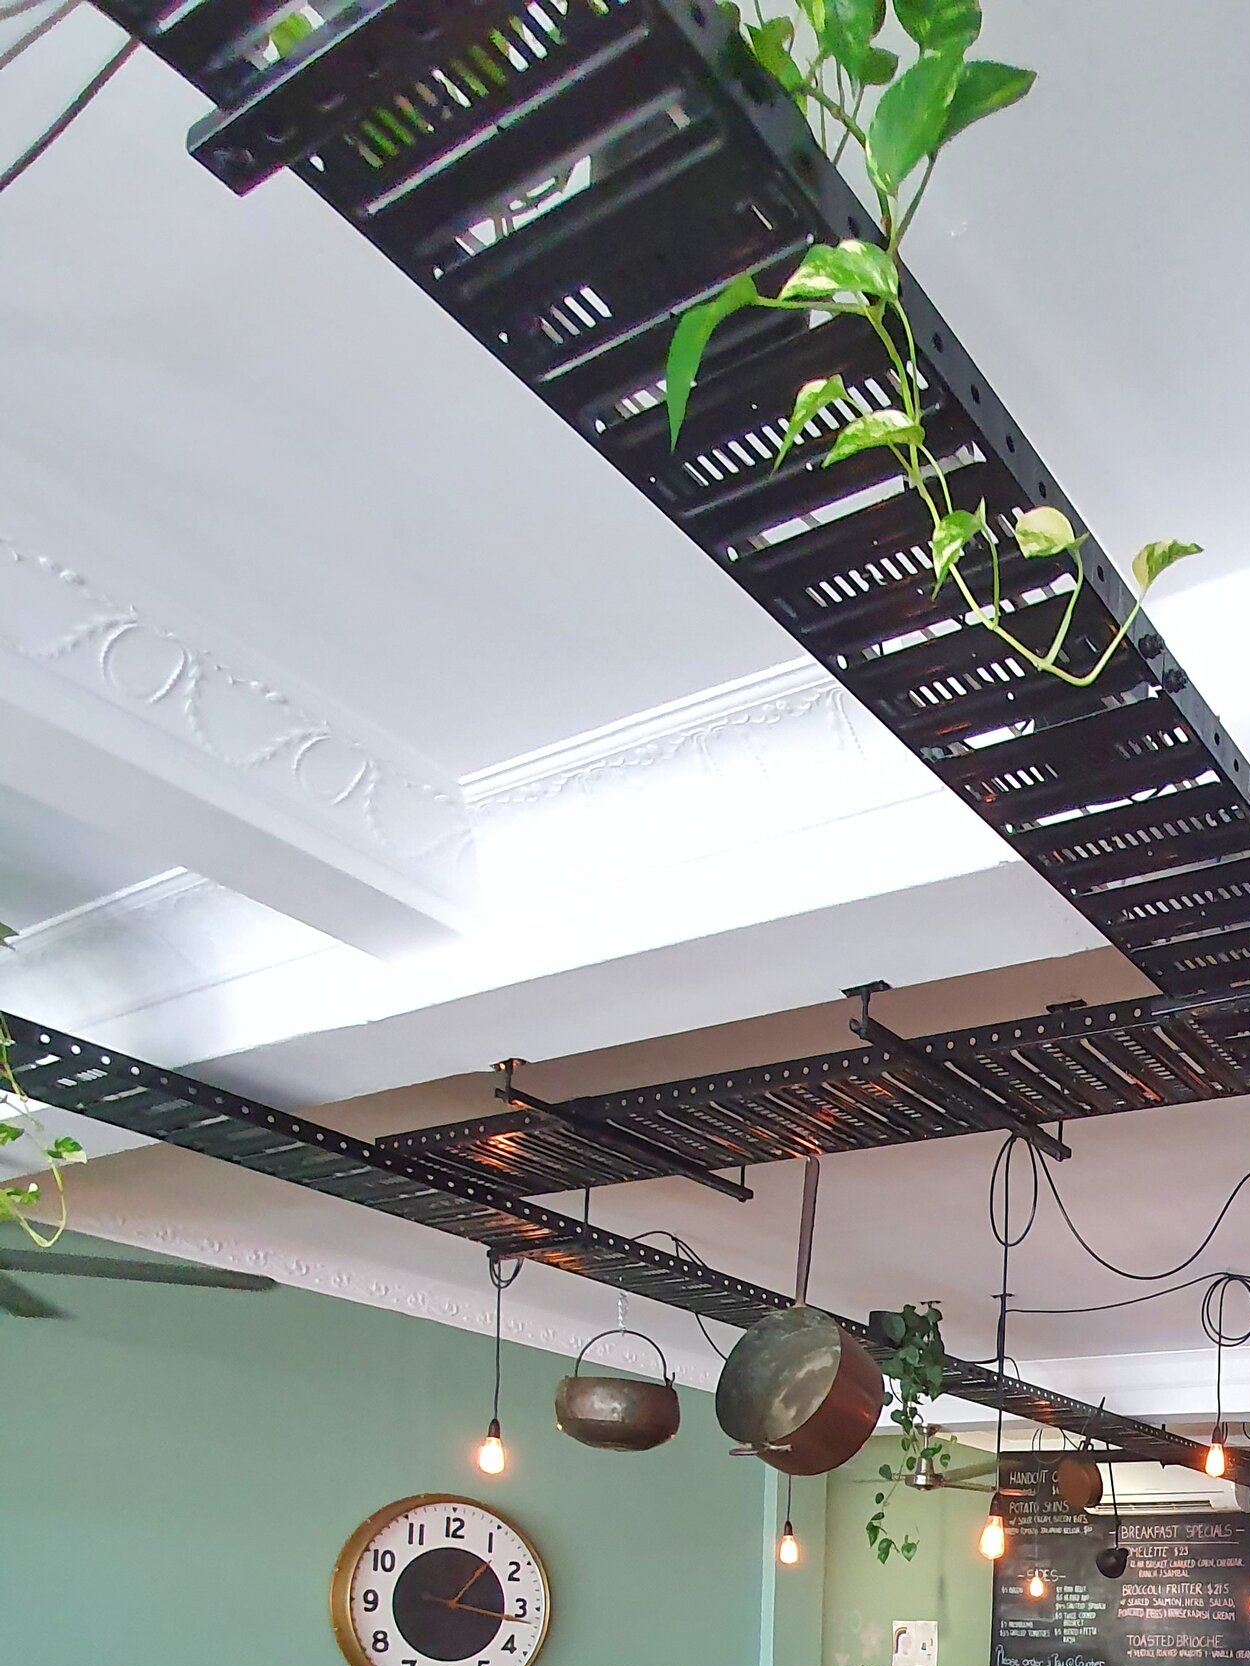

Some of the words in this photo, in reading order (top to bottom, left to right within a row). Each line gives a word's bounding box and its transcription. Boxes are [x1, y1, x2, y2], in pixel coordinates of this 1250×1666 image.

[1009, 1501, 1040, 1514] POTATO
[408, 1522, 425, 1545] 11
[445, 1516, 465, 1539] 12
[1121, 1525, 1181, 1540] BREAKFAST
[1186, 1524, 1235, 1539] SPECIALS
[487, 1532, 494, 1553] 1
[372, 1549, 396, 1572] 10
[507, 1561, 522, 1582] 2
[1122, 1584, 1163, 1596] BROCCOLI
[1166, 1582, 1204, 1595] FRITTER
[363, 1589, 379, 1613] 9
[514, 1598, 528, 1619] 3
[371, 1630, 389, 1653] 8
[501, 1634, 518, 1655] 4
[1126, 1634, 1174, 1648] TOASTED
[1176, 1634, 1224, 1649] BRIOCHE
